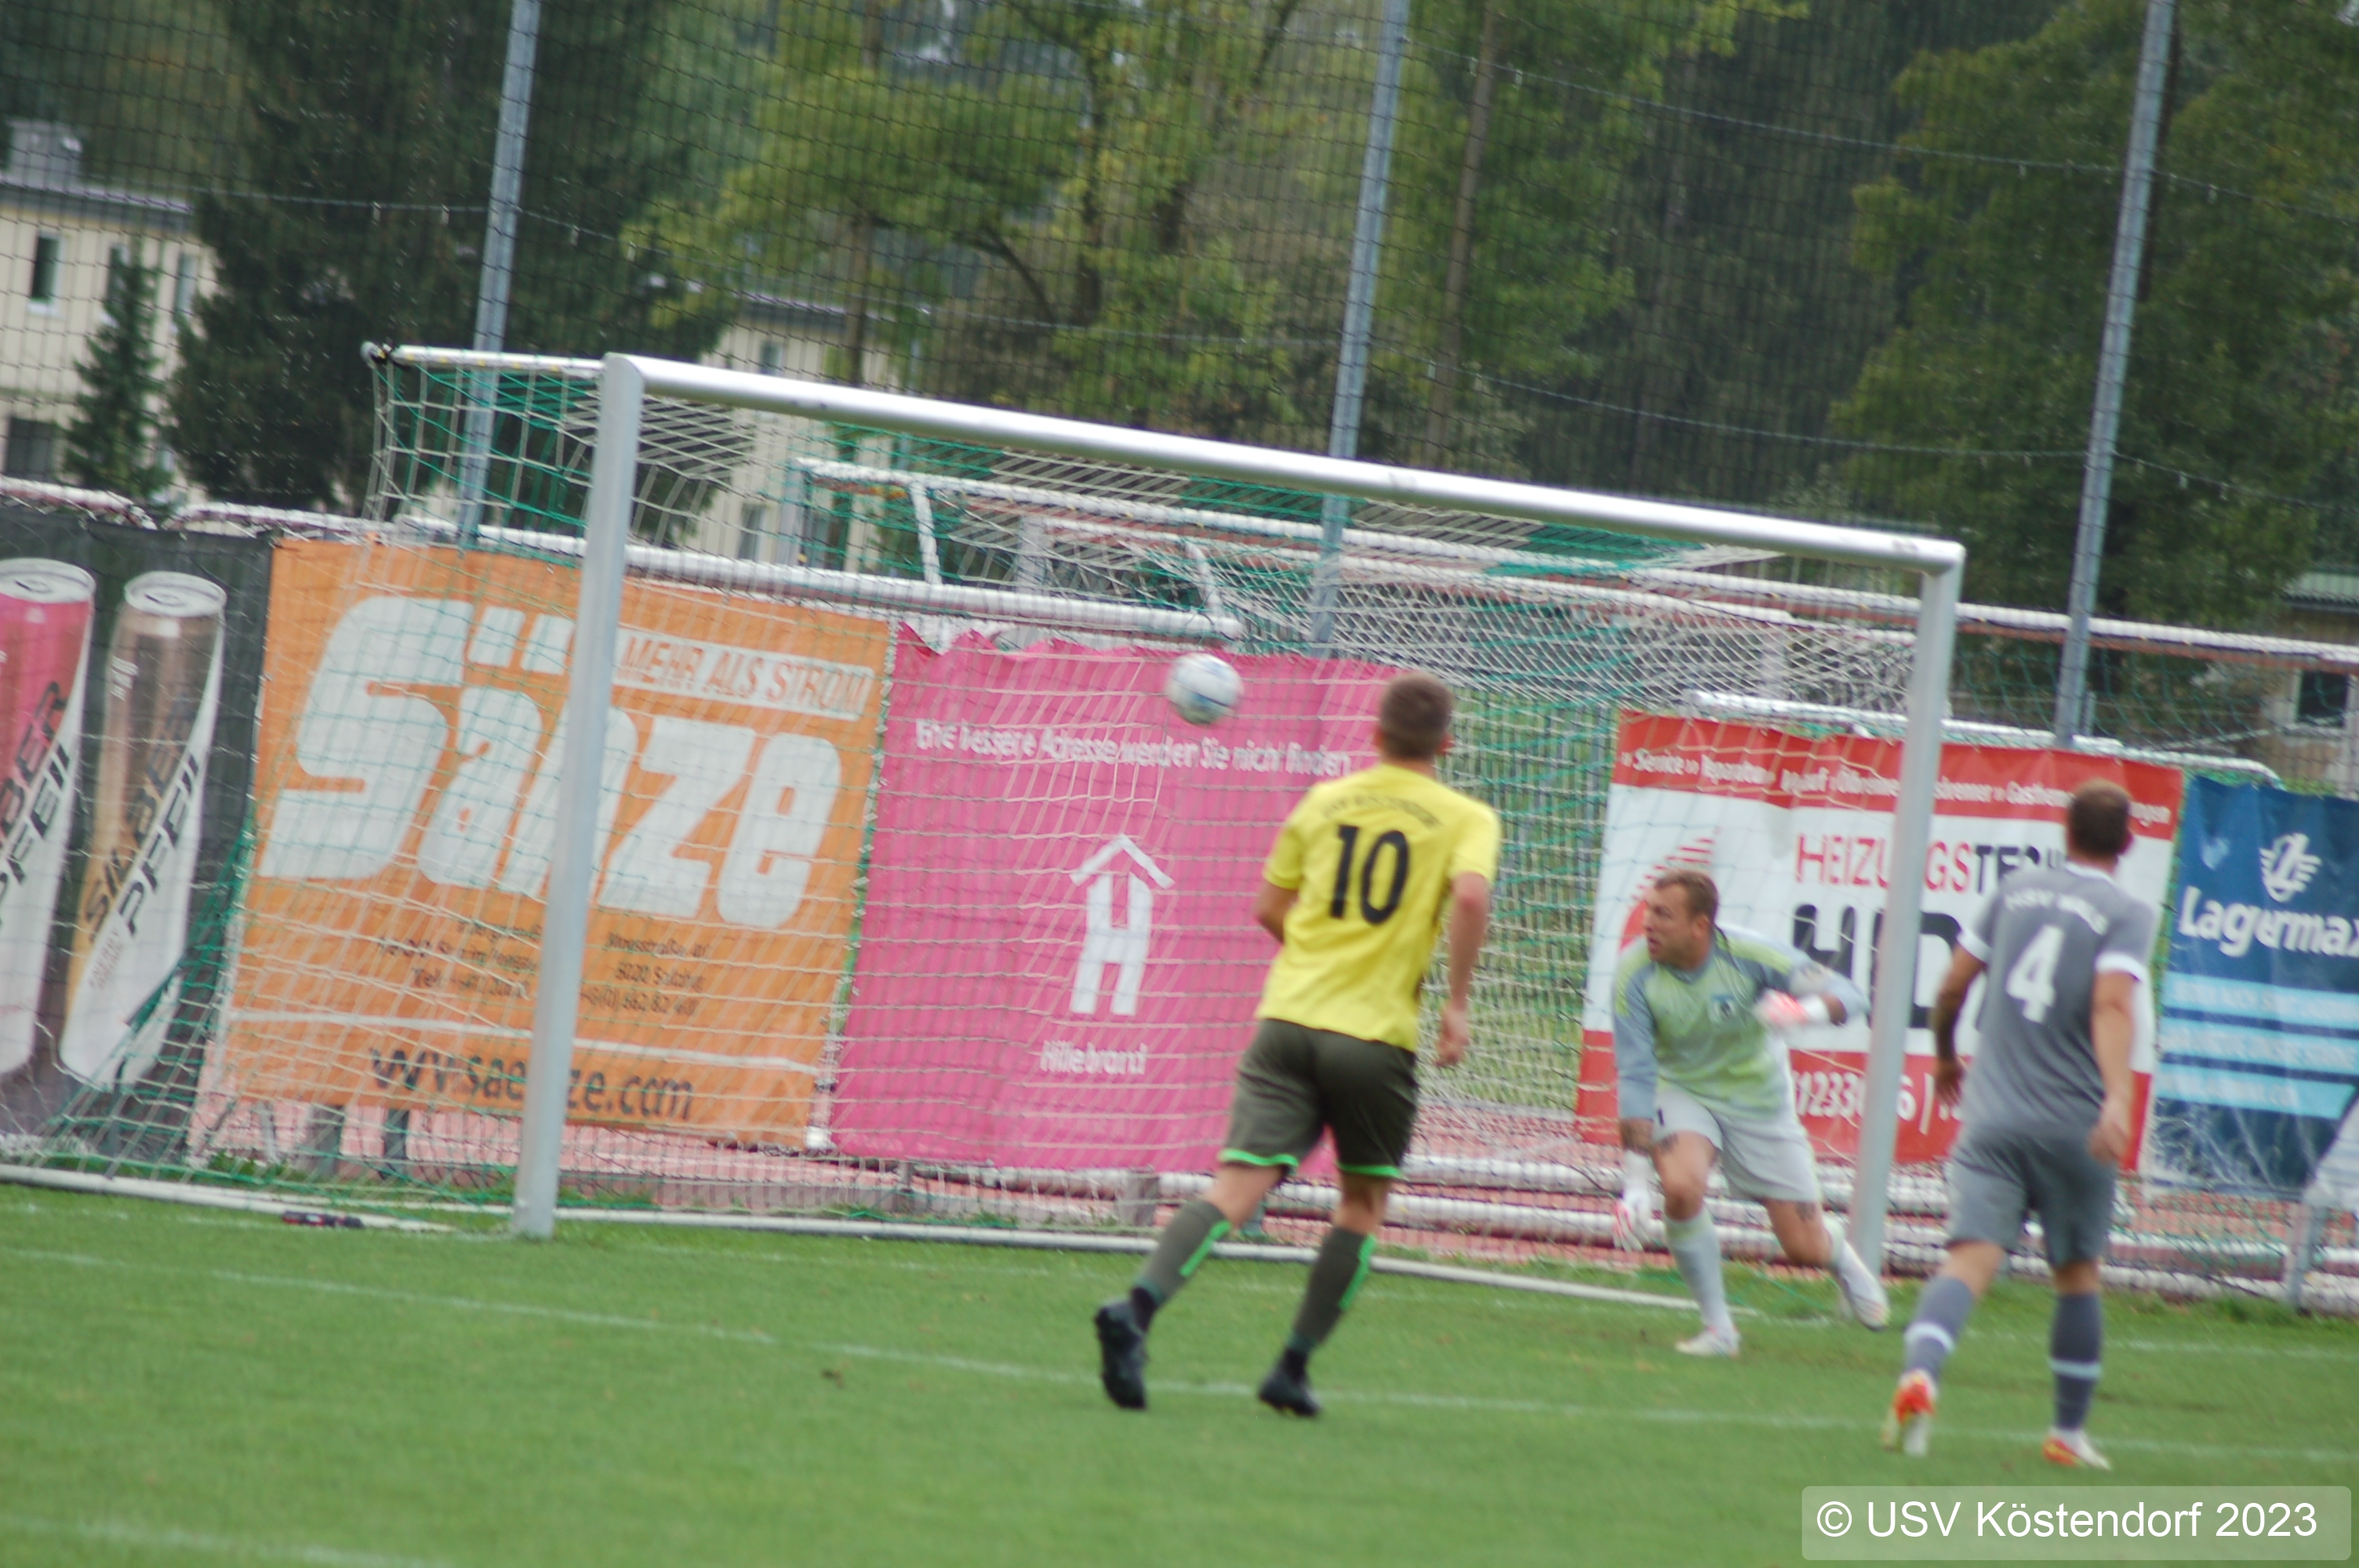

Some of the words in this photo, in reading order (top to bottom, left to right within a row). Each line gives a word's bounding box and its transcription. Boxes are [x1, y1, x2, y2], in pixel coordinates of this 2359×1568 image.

[704, 652, 764, 699] ALS
[765, 660, 871, 713] STROM
[1200, 736, 1230, 771] Sie
[118, 754, 199, 936] PFEIL
[1329, 823, 1409, 927] 10
[2005, 924, 2065, 1023] 4
